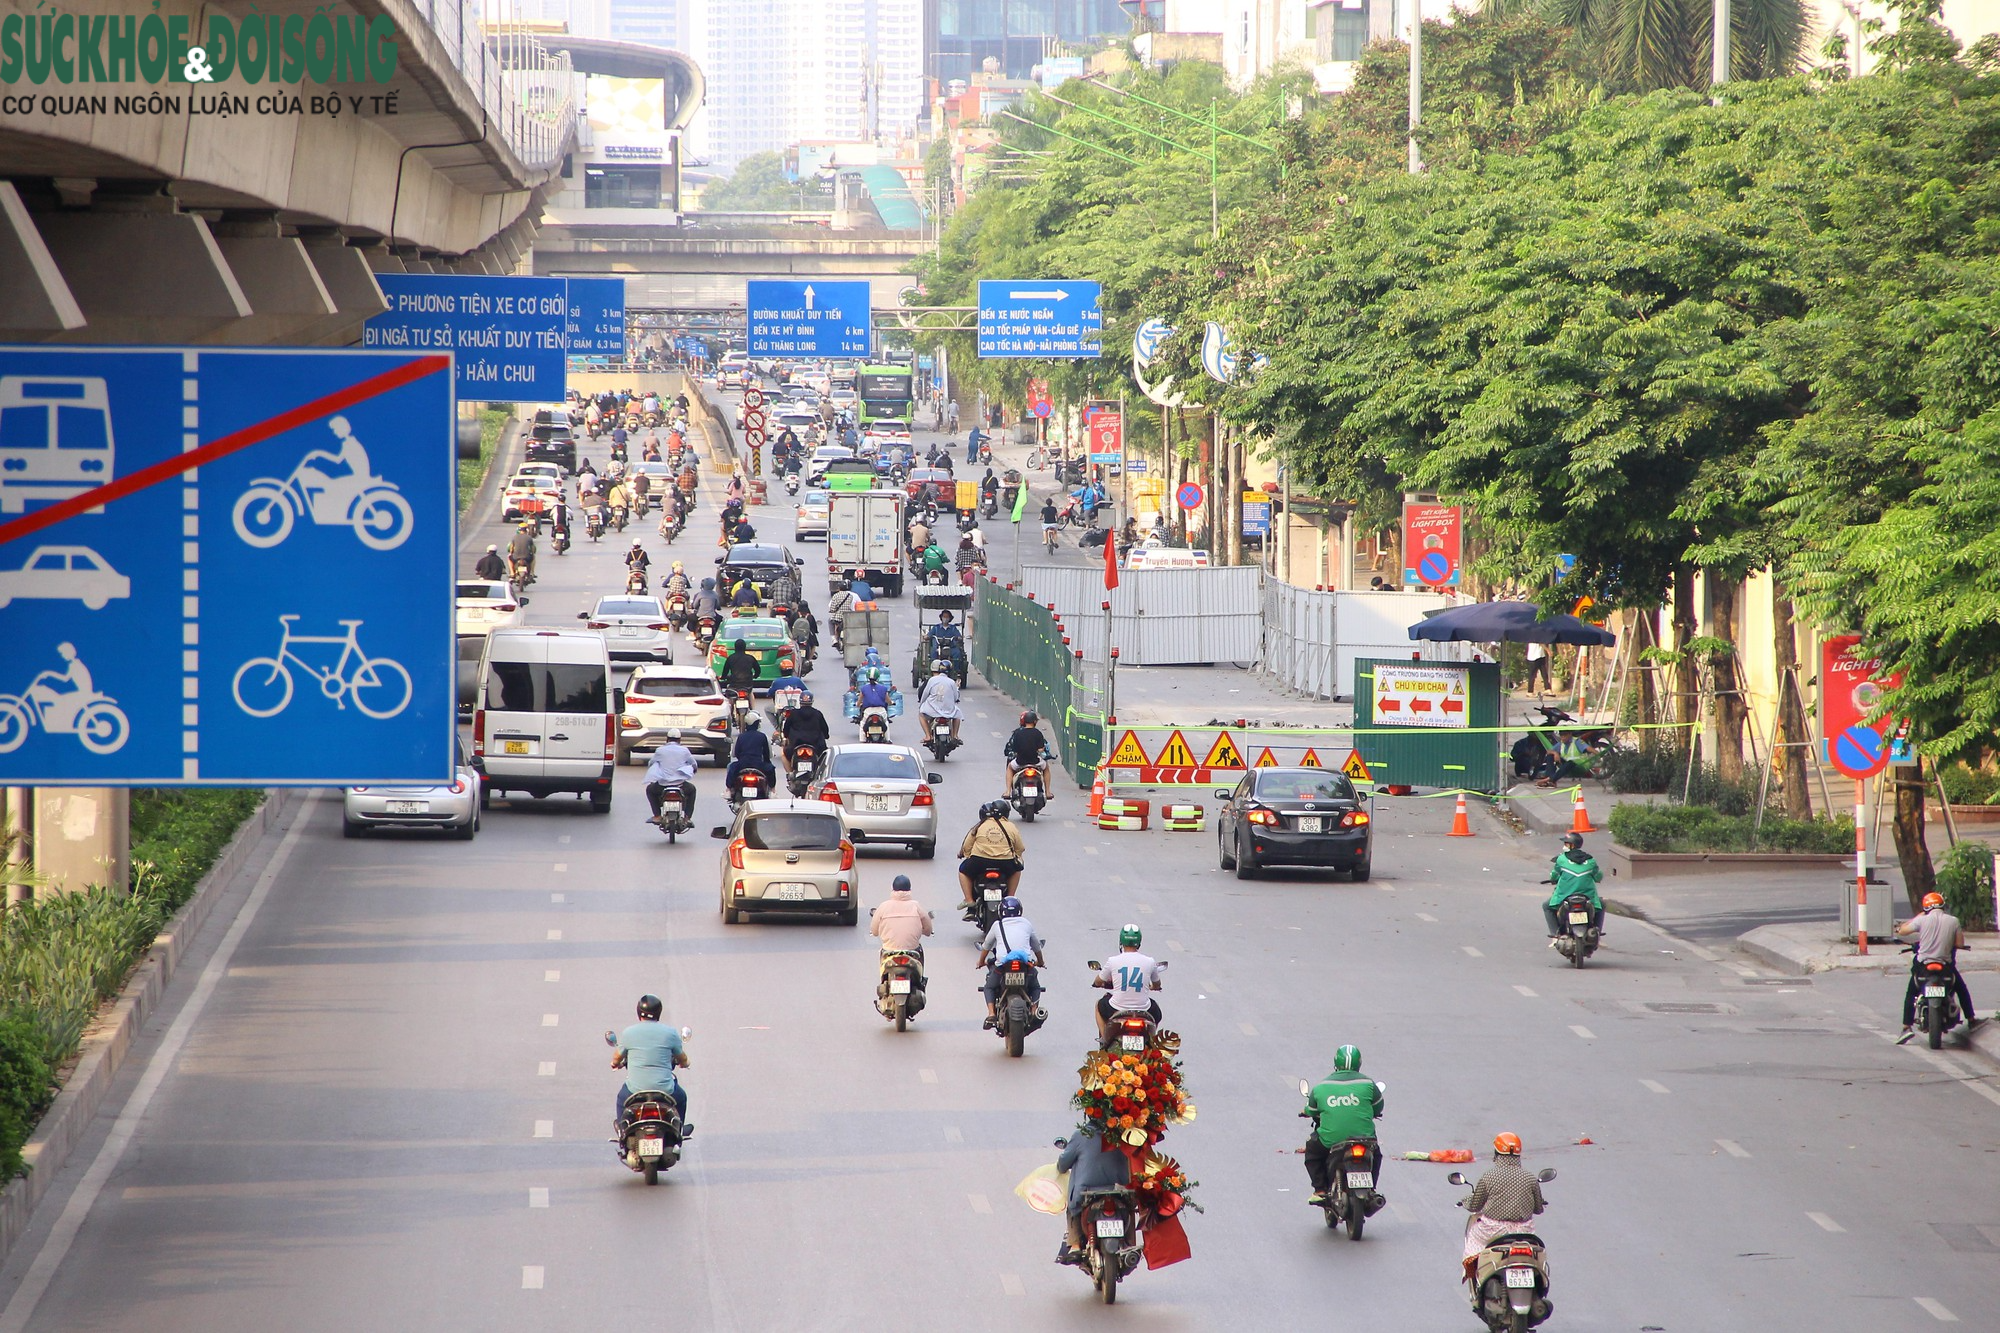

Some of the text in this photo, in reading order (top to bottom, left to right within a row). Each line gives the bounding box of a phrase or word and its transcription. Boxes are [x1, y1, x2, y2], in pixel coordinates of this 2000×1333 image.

[399, 294, 455, 312] PHƯƠNG
[460, 292, 491, 316] TIỆN
[495, 297, 514, 314] XE
[518, 296, 537, 315] CƠ
[540, 293, 565, 316] GIỚI
[602, 308, 608, 318] 3
[610, 308, 622, 317] km
[753, 307, 842, 320] ĐƯỜNG KHUẤT DUY TIẾN
[980, 307, 1100, 320] BẾN XE NƯỚC NGẦM 5 km
[610, 324, 622, 333] km
[753, 323, 865, 336] BẾN XE MỸ ĐÌNH 6 km
[980, 326, 995, 335] CAO
[997, 323, 1011, 335] TỐC
[1012, 324, 1031, 335] PHÁP
[365, 327, 379, 345] ĐI
[382, 325, 409, 346] NGÃ
[412, 327, 431, 346] TƯ
[458, 323, 501, 348] KHUẤT
[505, 330, 532, 348] DUY
[535, 325, 565, 349] TIẾN
[573, 337, 592, 348] GIÁM
[610, 340, 622, 348] km
[753, 339, 865, 351] CẦU THĂNG LONG 14 km
[980, 341, 995, 351] CAO
[997, 338, 1011, 351] TỐC
[1012, 339, 1021, 351] HÀ
[1053, 339, 1078, 351] PHÒNG
[466, 357, 498, 382] HẦM
[503, 364, 535, 382] CHUI
[1411, 519, 1455, 528] LIGHT BOX
[1831, 659, 1871, 672] LIGHT
[1395, 680, 1410, 690] CHÚ
[1411, 681, 1417, 690] Ý
[1116, 753, 1142, 764] CHẬM
[1118, 966, 1143, 992] 14
[1327, 1093, 1360, 1107] Grab
